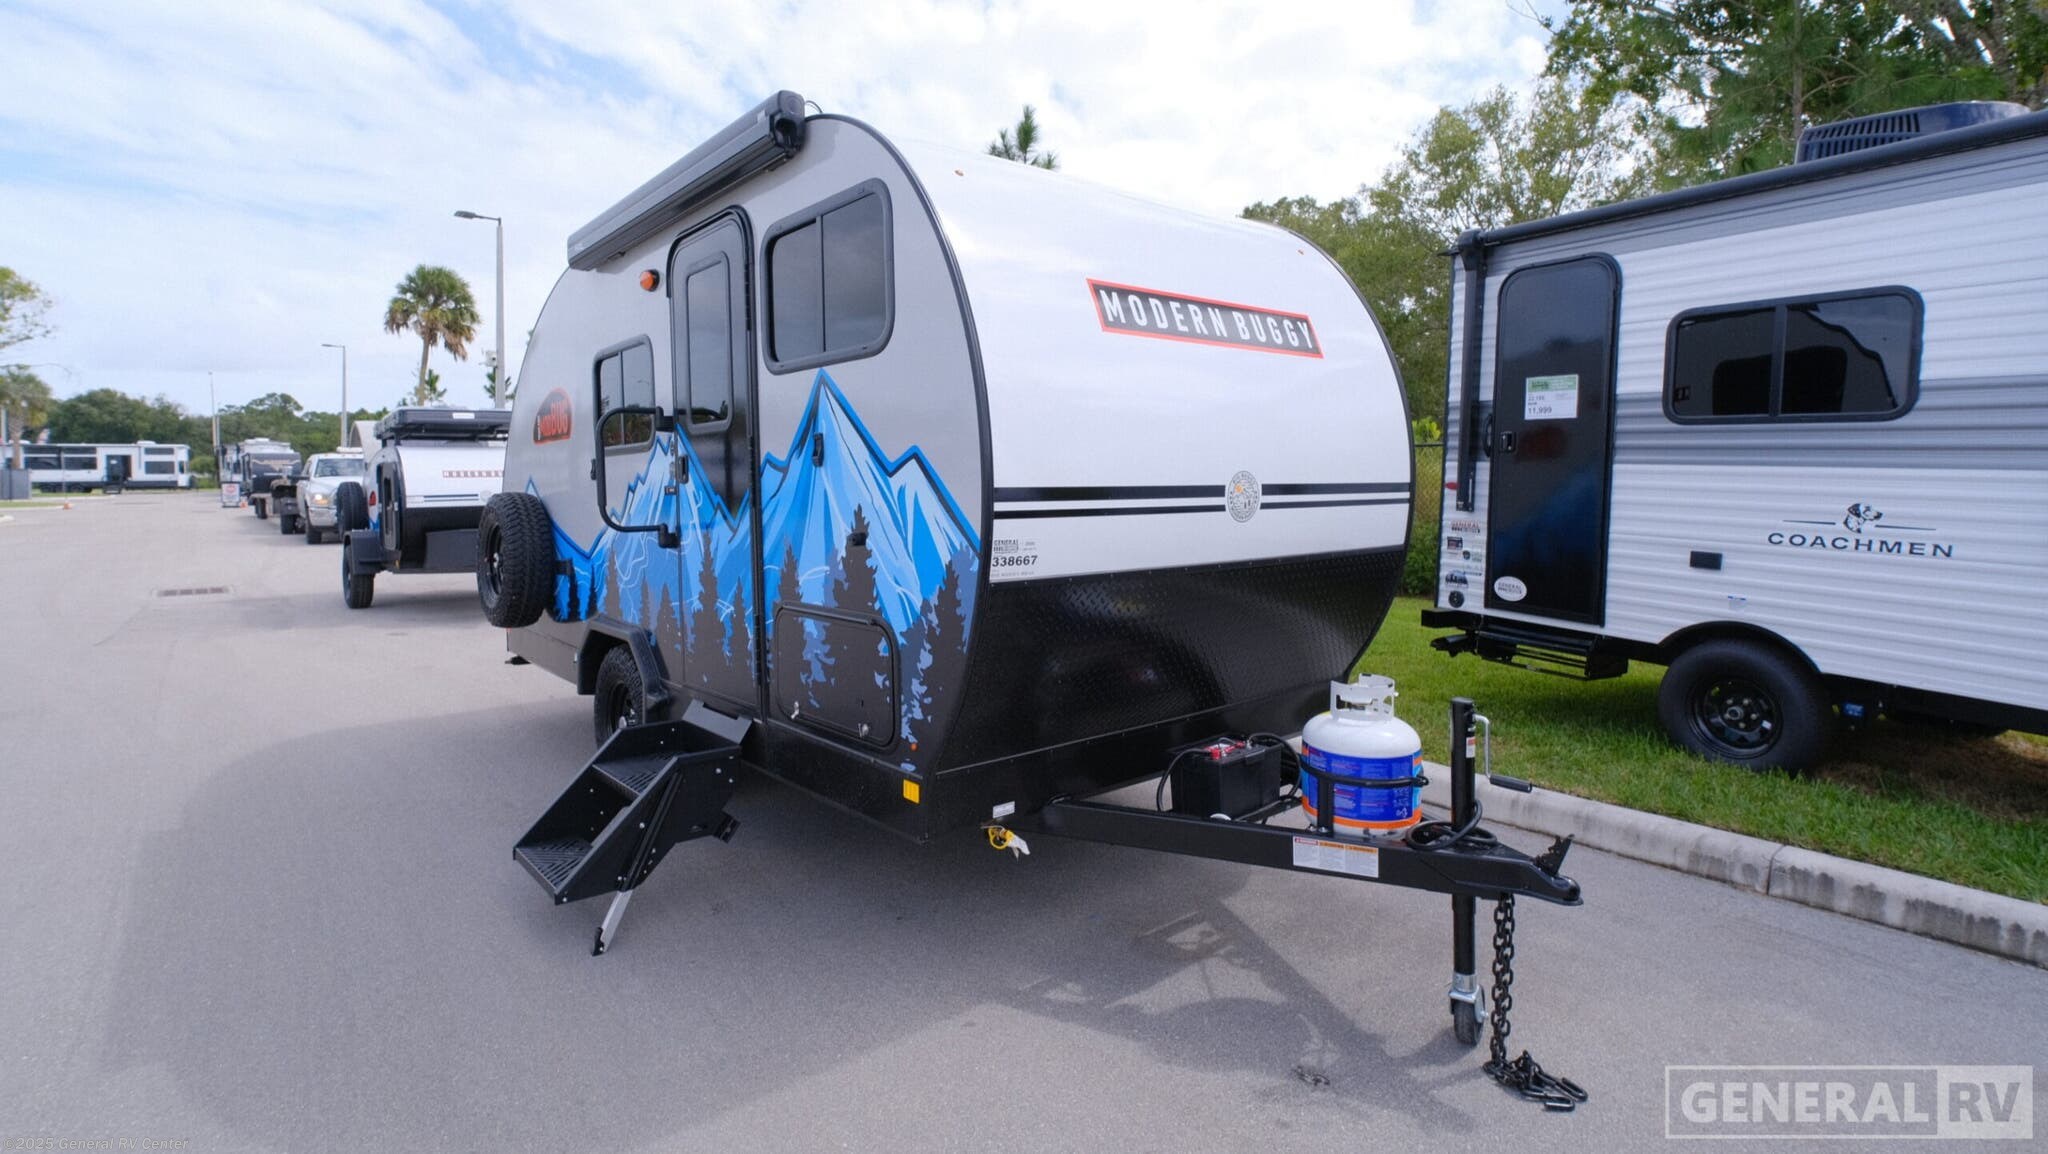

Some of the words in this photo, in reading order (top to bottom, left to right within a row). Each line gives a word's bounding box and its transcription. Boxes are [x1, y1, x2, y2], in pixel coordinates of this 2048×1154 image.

[1099, 289, 1228, 338] MODERN
[1232, 310, 1314, 349] BUGGY
[1767, 532, 1954, 558] COACHMEN
[992, 554, 1038, 567] 338667
